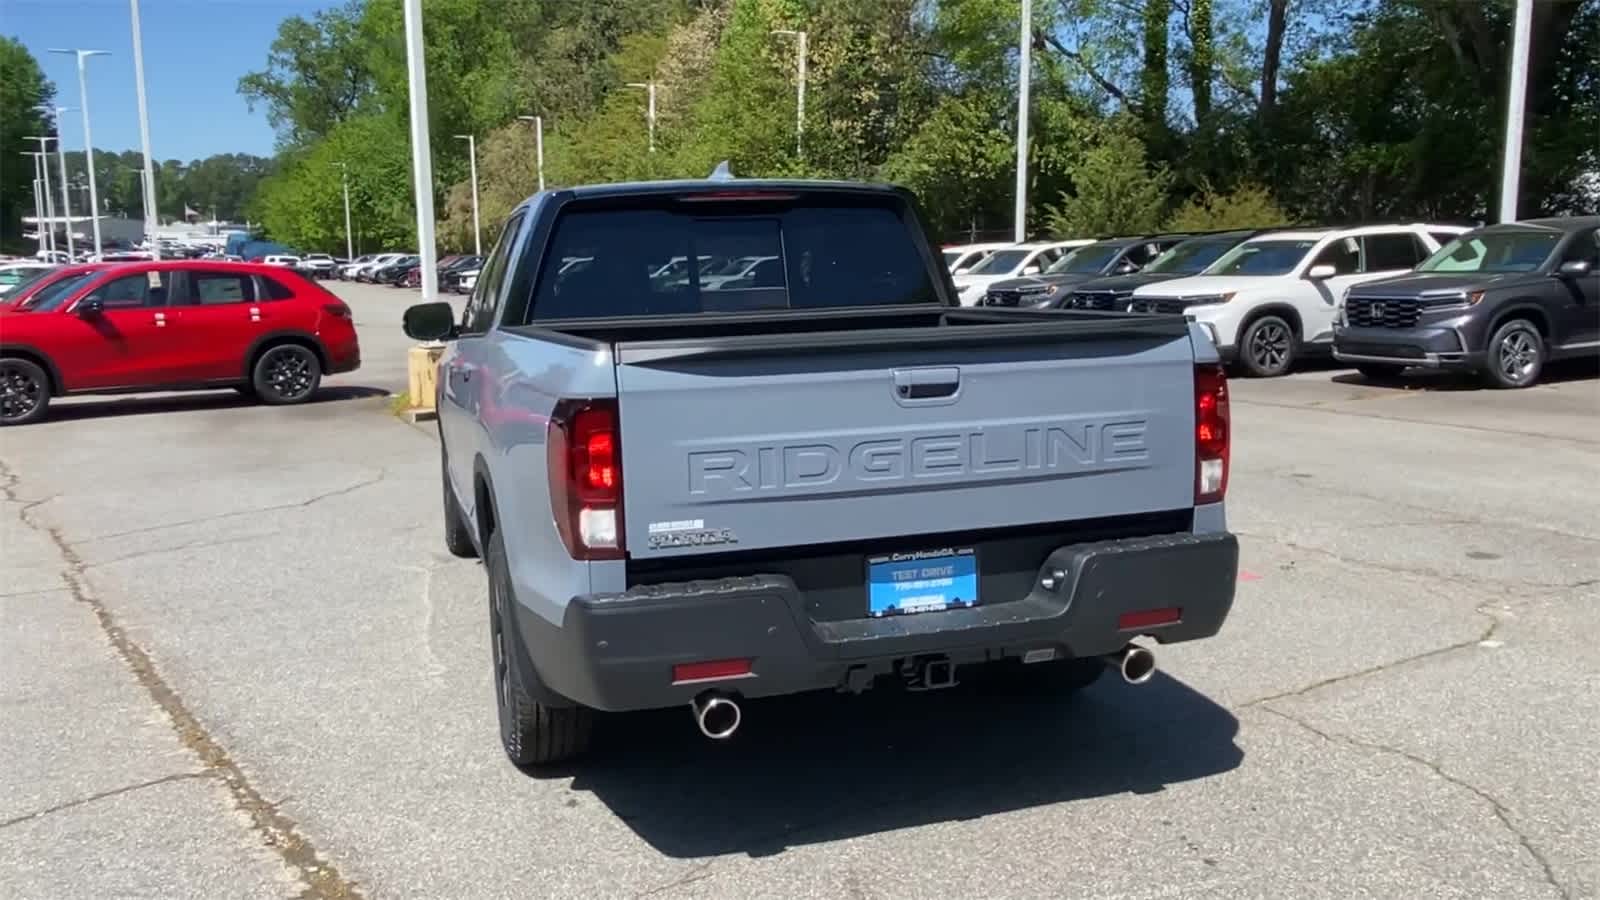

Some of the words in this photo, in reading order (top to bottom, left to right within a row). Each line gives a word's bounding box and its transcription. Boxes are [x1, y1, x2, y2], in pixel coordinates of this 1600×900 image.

[687, 419, 1150, 496] RIDGELINE
[892, 569, 918, 581] TEST
[921, 566, 954, 579] DRIVE
